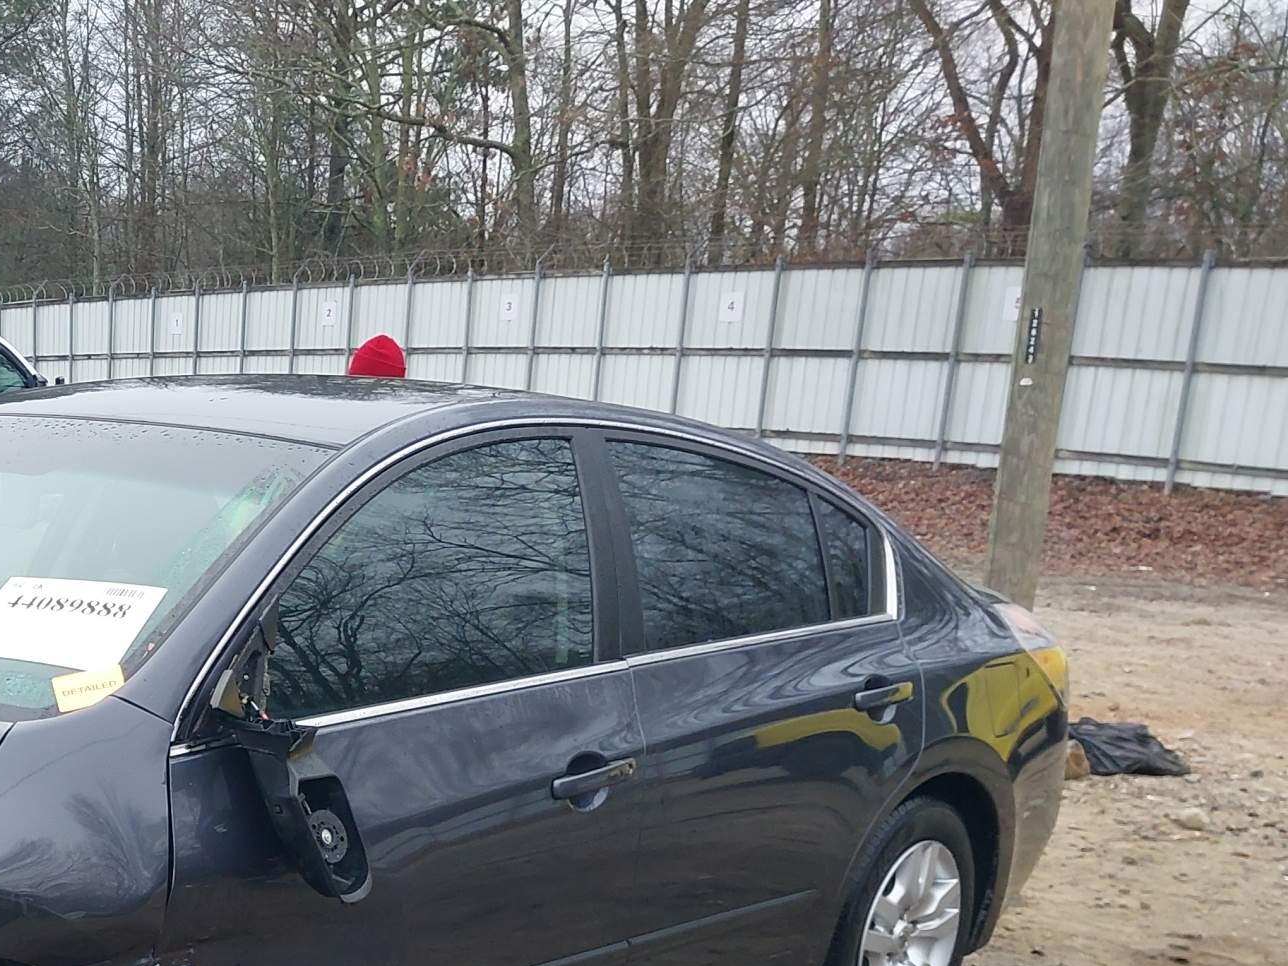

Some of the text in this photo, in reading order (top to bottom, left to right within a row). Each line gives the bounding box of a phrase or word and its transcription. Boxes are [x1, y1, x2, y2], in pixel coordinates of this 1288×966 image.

[506, 302, 512, 311] 3
[7, 595, 132, 619] 44089888
[62, 680, 117, 697] DETAILED
